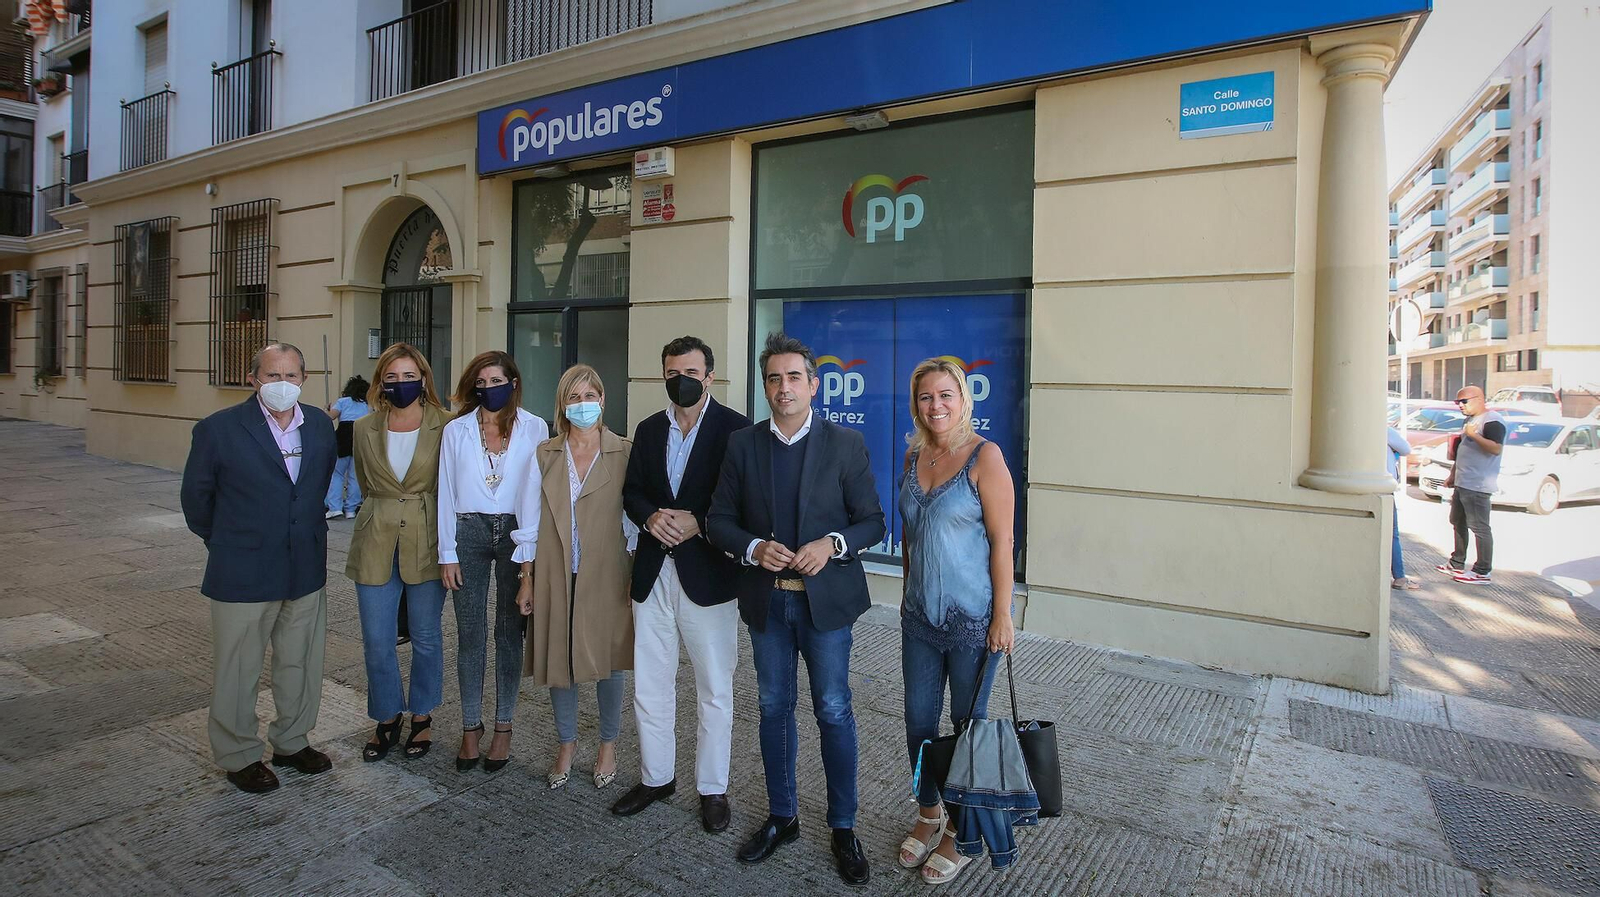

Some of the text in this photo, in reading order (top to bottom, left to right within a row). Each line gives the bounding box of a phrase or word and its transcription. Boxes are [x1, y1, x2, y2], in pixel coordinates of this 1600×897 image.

[1213, 90, 1240, 100] Calle
[1182, 97, 1273, 117] SANTO DOMINGO
[513, 96, 663, 162] populares
[393, 173, 400, 188] 7
[820, 408, 865, 424] Jerez
